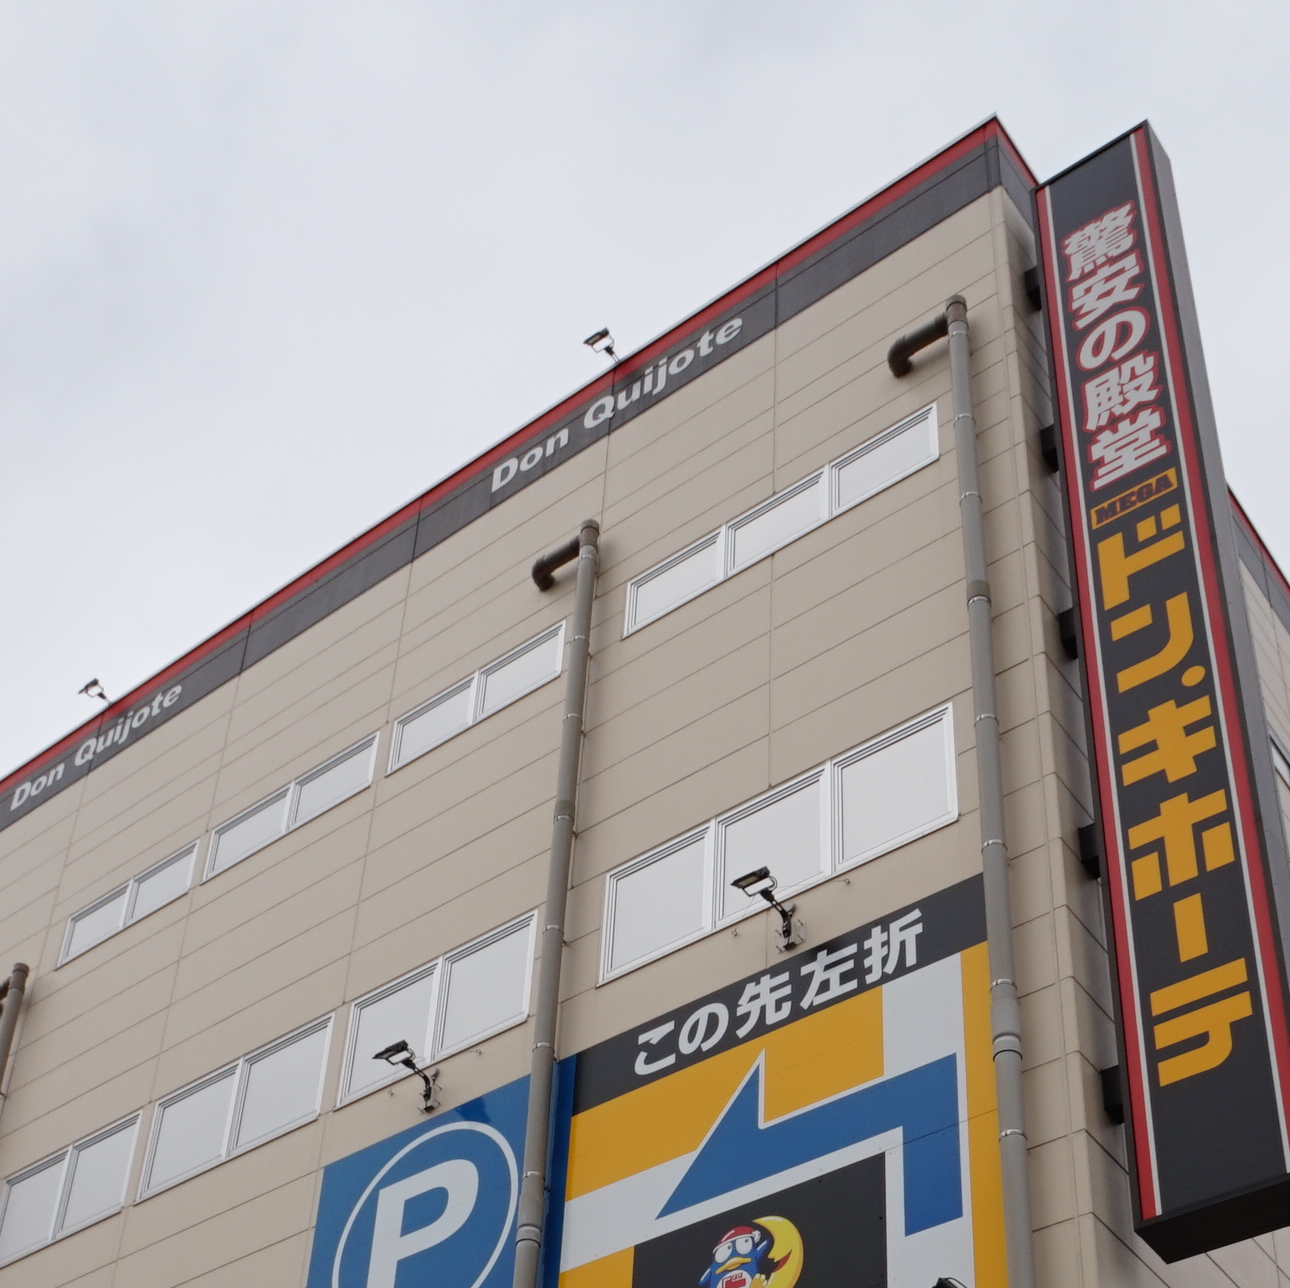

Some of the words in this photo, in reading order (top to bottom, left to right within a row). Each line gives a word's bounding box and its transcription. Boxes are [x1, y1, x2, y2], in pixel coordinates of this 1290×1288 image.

[491, 427, 569, 493] Don
[583, 317, 743, 430] Quijote
[1061, 202, 1172, 492] 驚安の殿堂
[1093, 474, 1175, 525] MEGA
[10, 762, 65, 811] Don
[74, 684, 182, 767] Quijote
[634, 908, 923, 1076] この先左折
